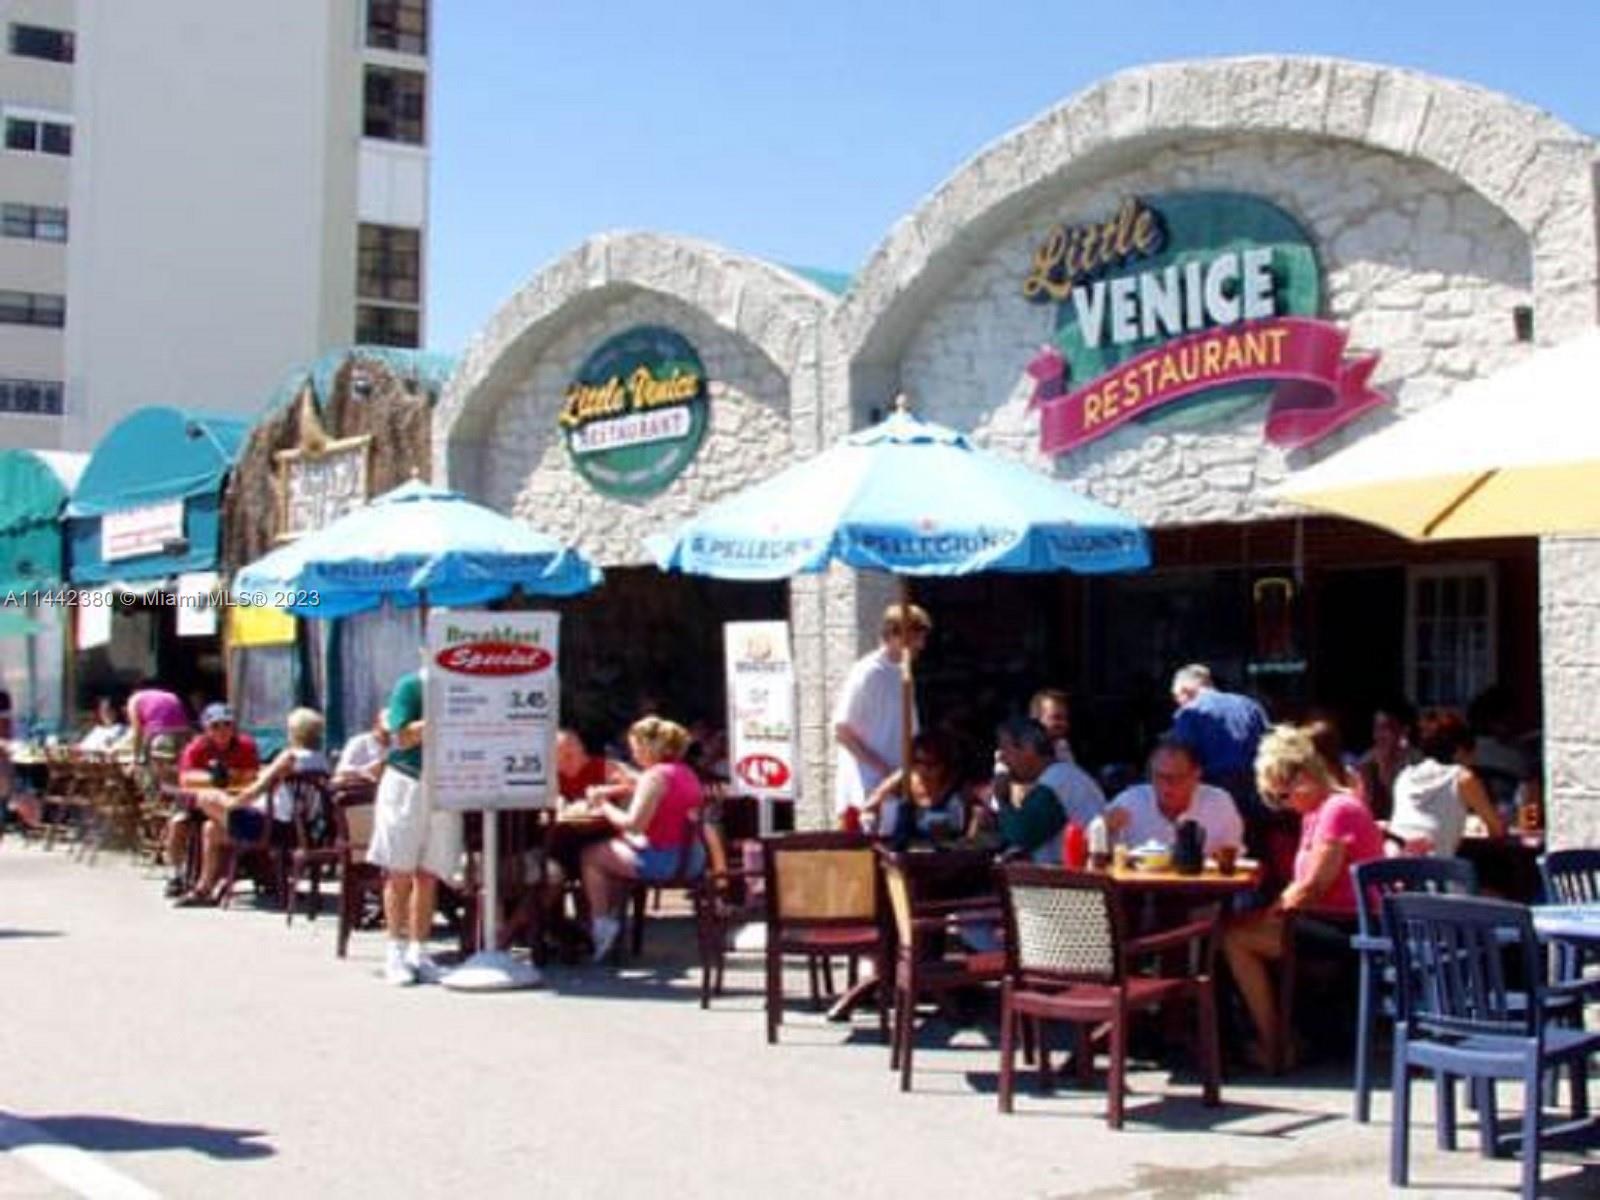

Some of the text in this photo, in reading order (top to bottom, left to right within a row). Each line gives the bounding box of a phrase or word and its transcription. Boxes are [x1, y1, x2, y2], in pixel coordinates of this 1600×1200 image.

[1022, 197, 1156, 298] Little
[1072, 246, 1276, 349] VENICE
[558, 375, 625, 426] Little
[1081, 328, 1288, 430] RESTAURANT
[448, 649, 542, 668] Special
